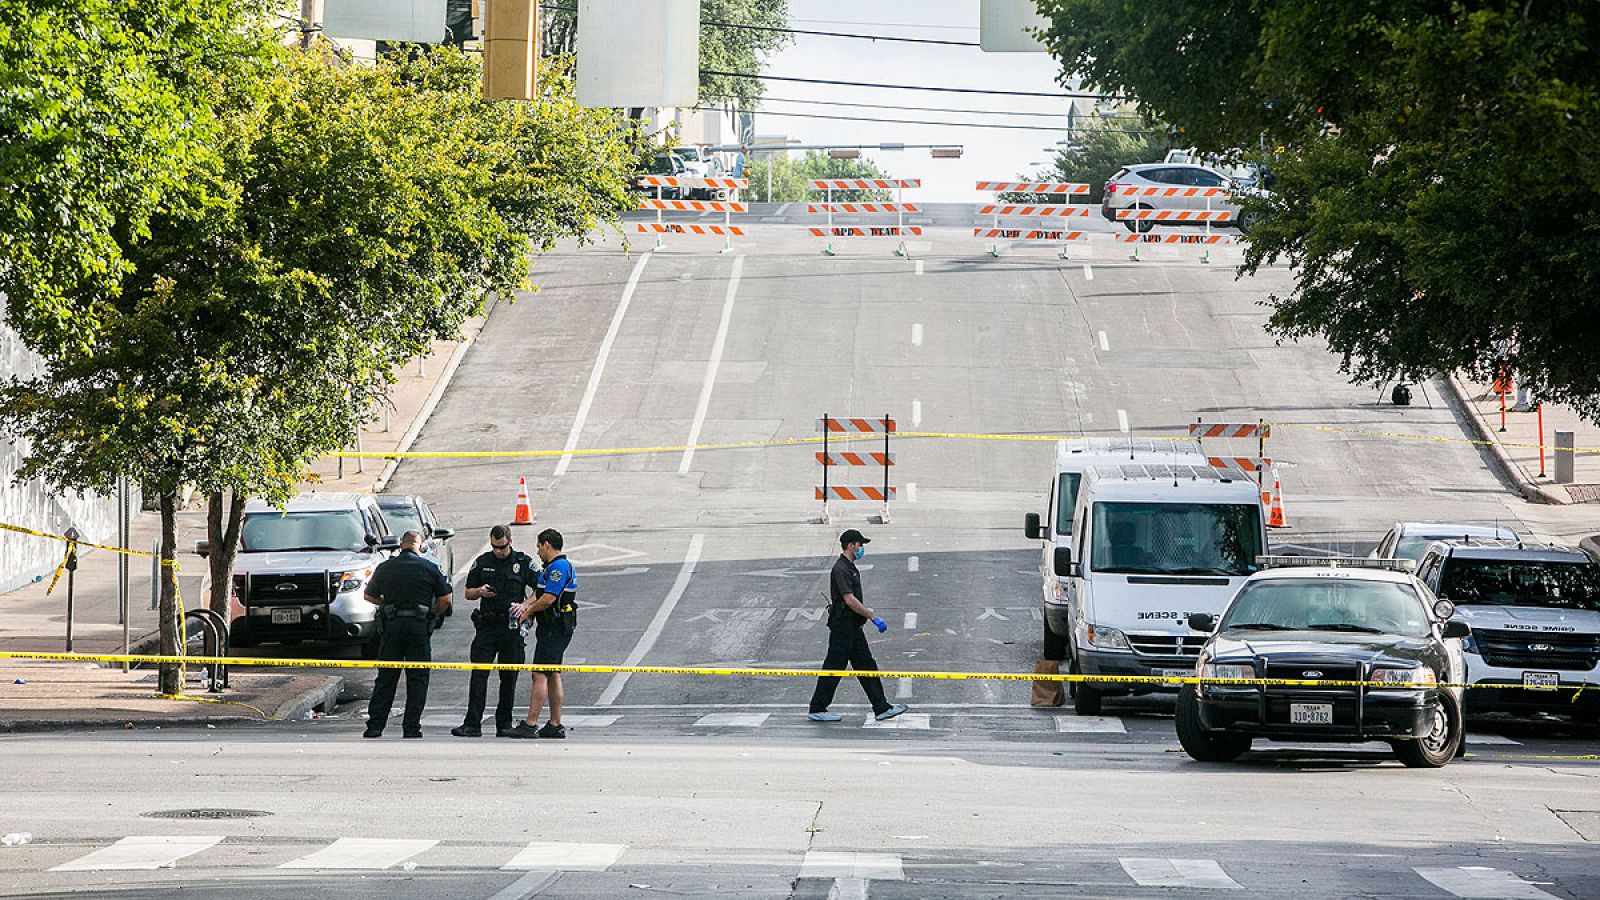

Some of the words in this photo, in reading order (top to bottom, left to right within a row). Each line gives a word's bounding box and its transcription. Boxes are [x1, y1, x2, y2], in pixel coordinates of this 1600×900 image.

[834, 228, 854, 236] APD
[998, 230, 1020, 238] APD
[1142, 234, 1162, 242] APD
